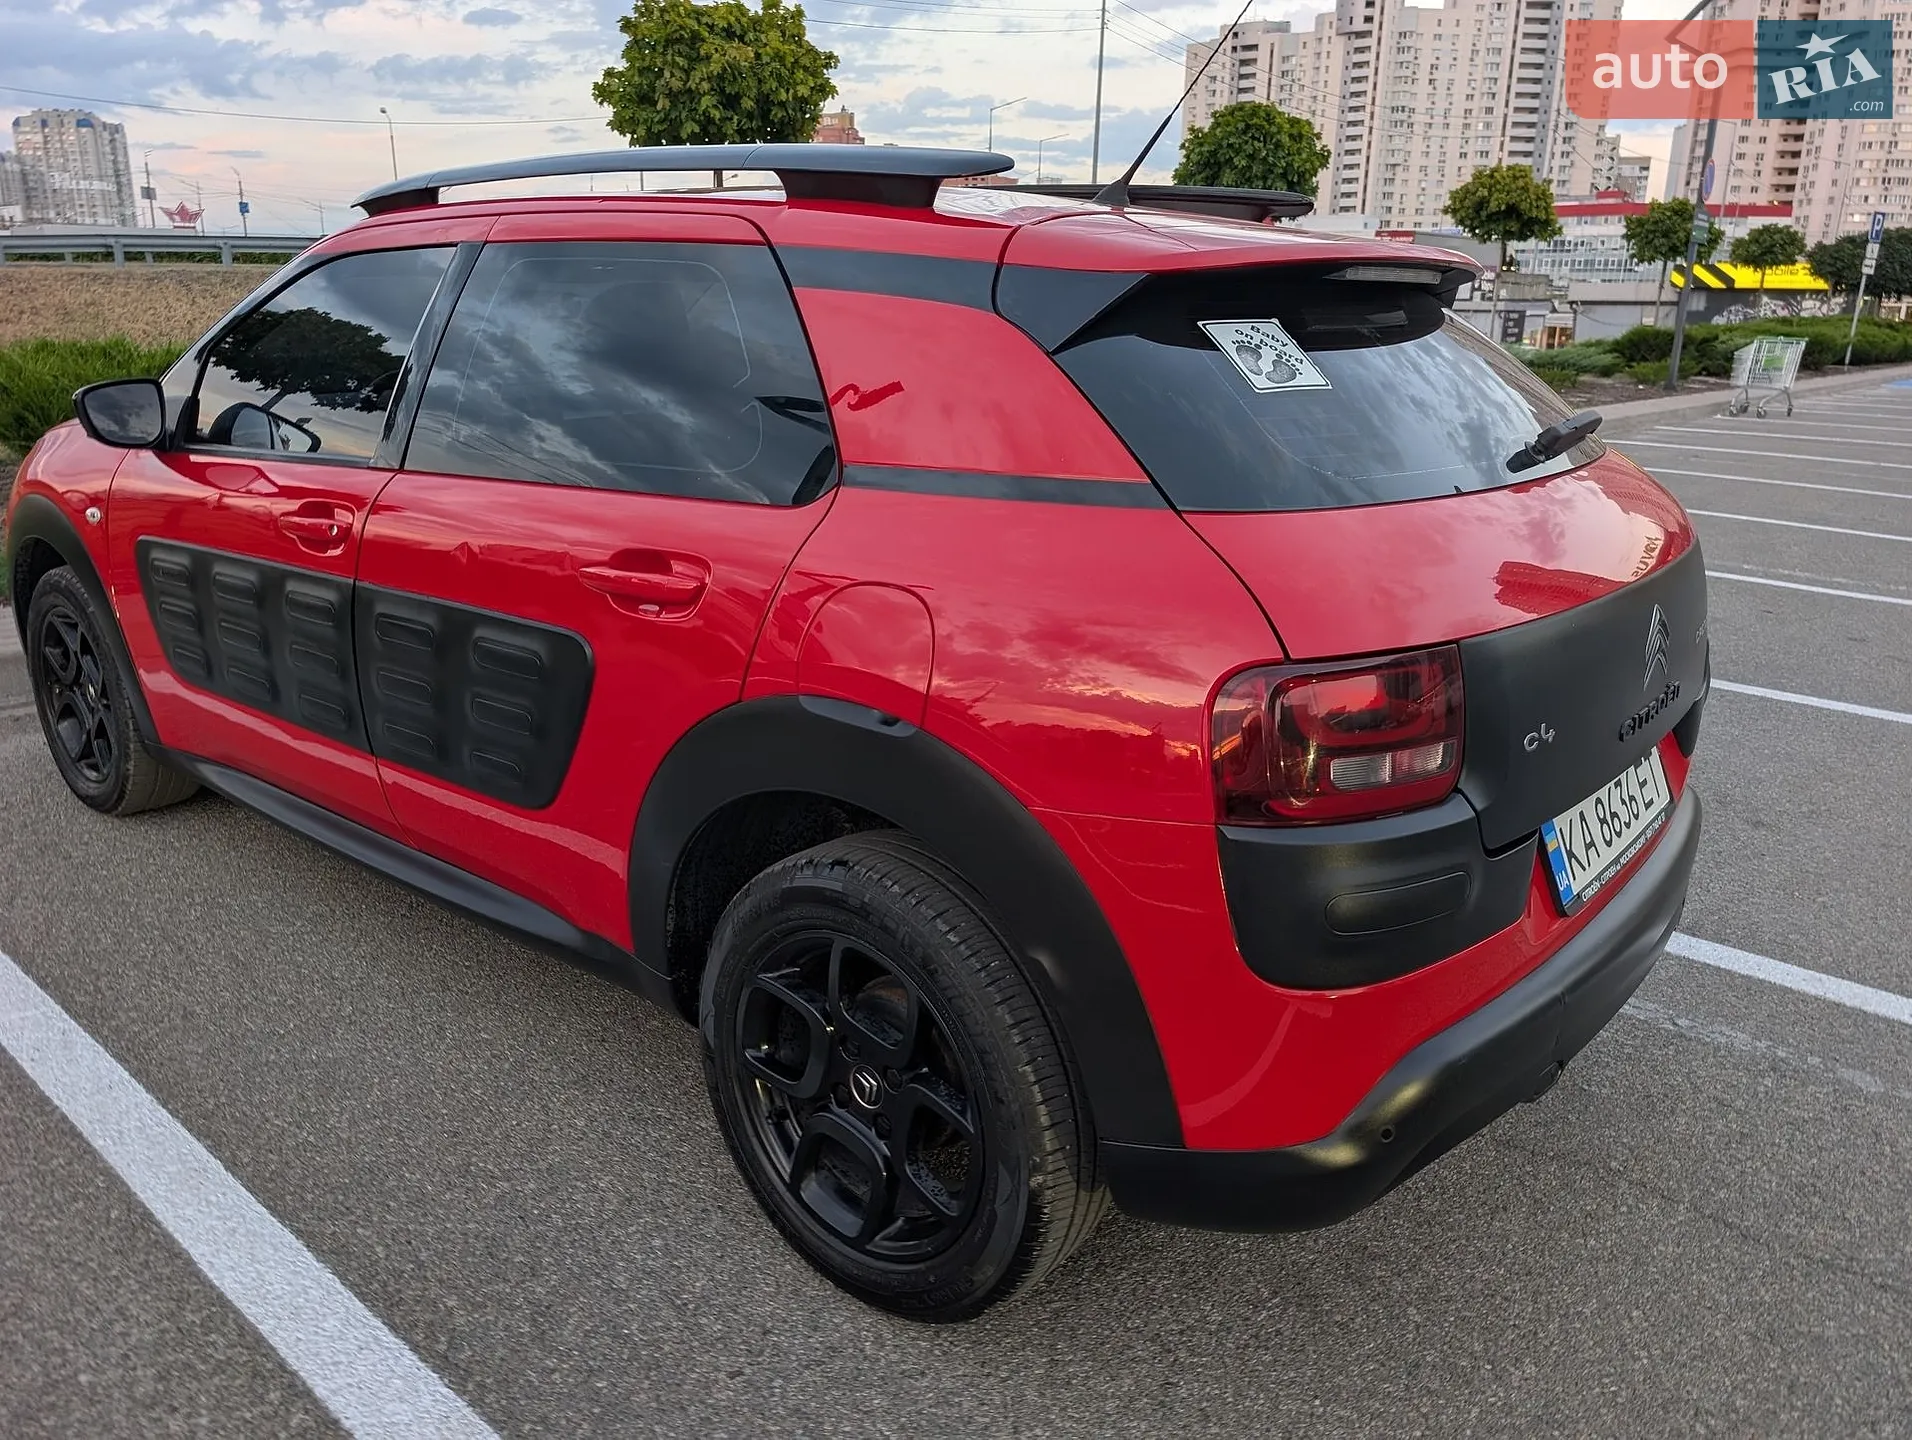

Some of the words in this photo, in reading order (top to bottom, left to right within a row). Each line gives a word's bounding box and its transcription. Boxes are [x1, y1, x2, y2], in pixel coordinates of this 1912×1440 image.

[1234, 329, 1254, 341] on
[1259, 338, 1304, 365] board
[1250, 324, 1289, 348] Baby
[1559, 810, 1600, 881] KA
[1594, 771, 1639, 848] 8636
[1556, 872, 1570, 891] UA
